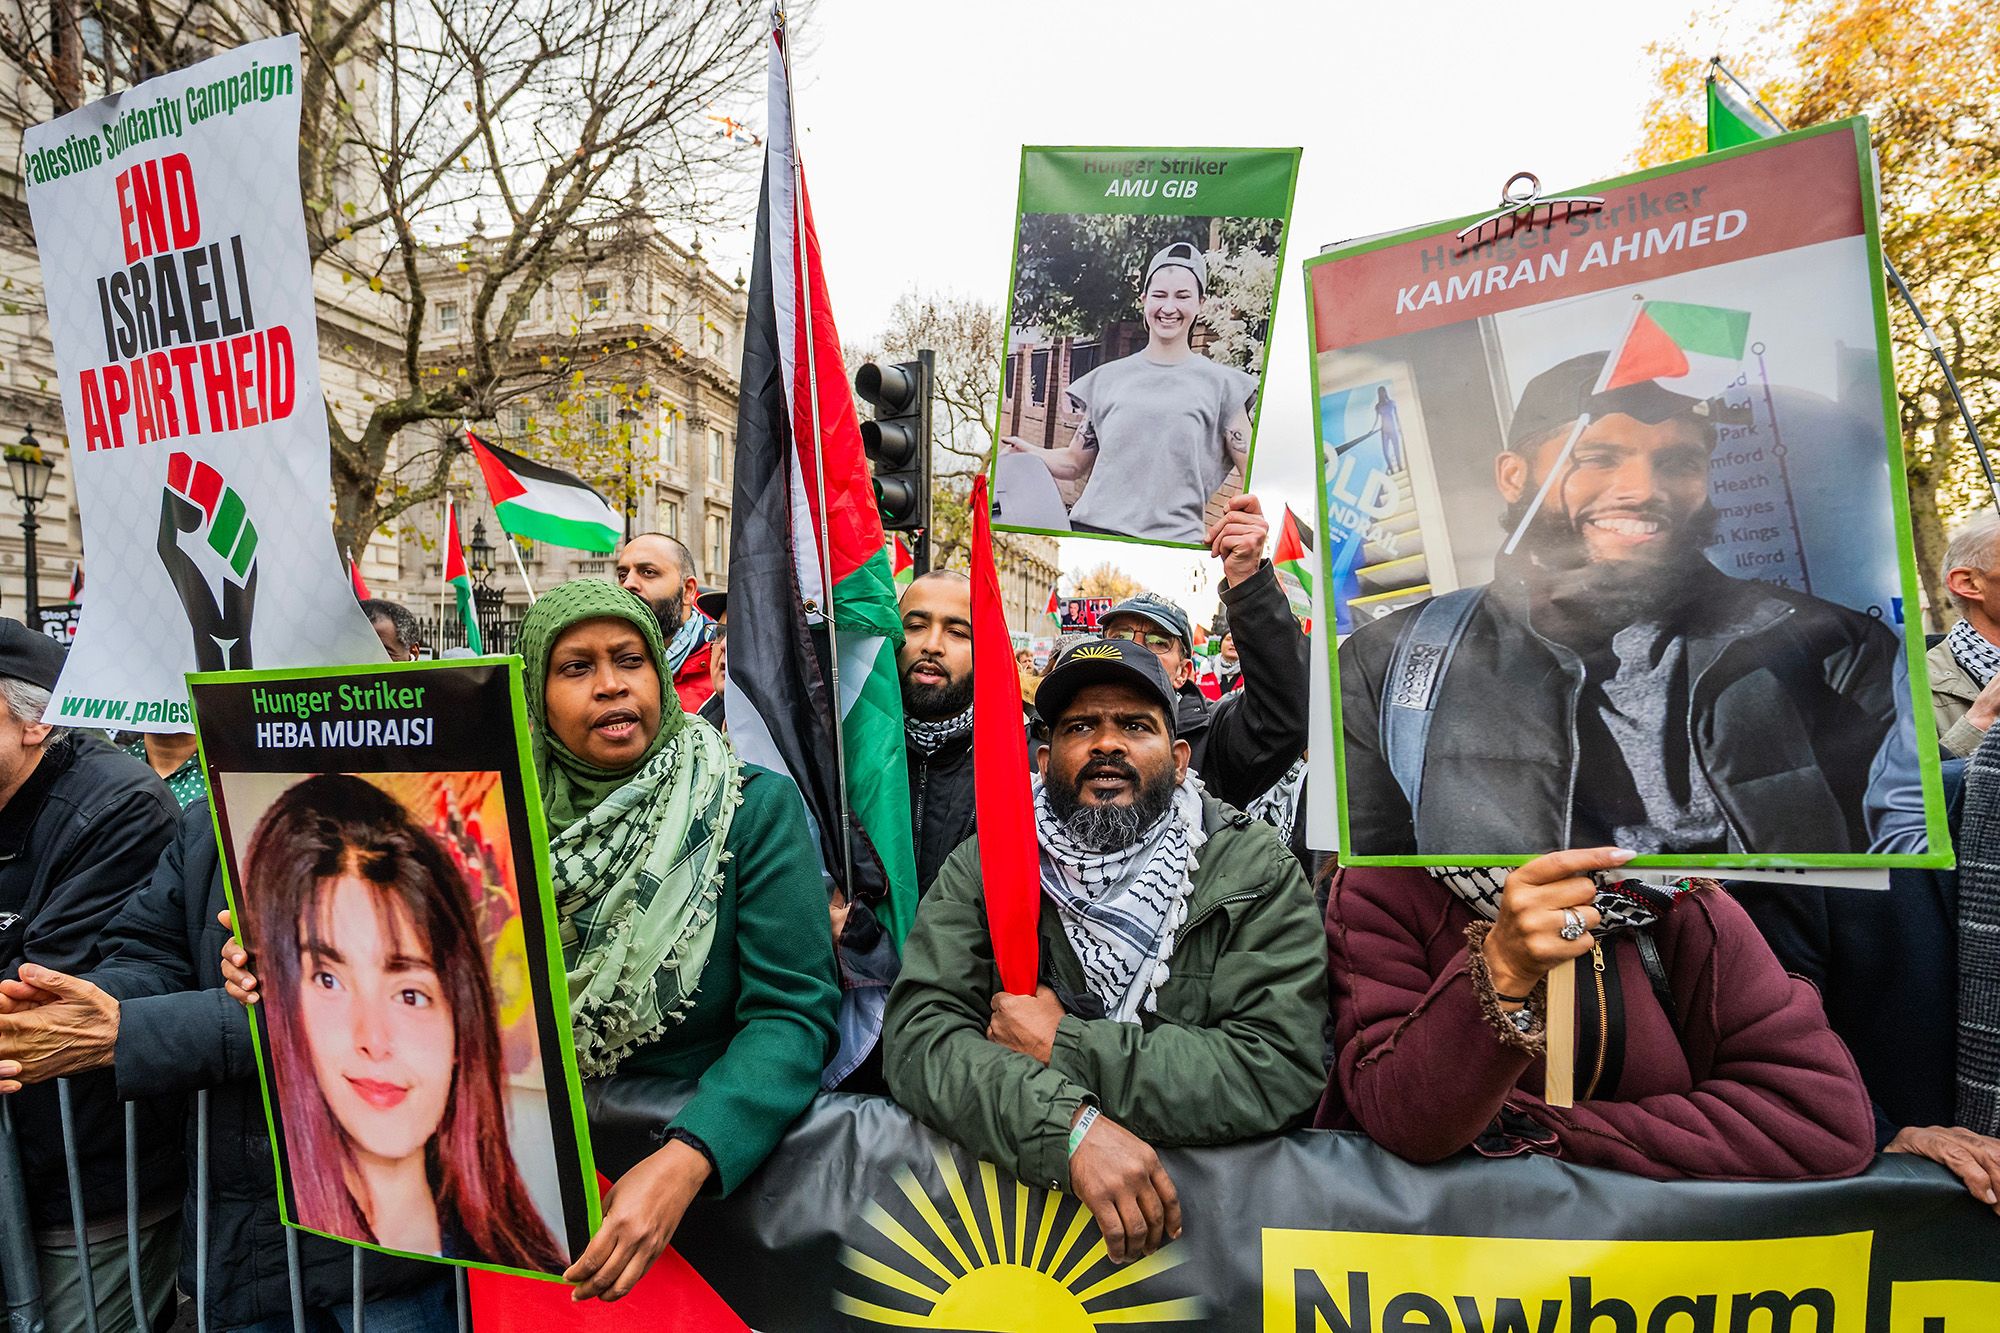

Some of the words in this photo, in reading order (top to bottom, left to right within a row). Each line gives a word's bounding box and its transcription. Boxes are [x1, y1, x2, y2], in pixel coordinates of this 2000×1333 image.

[25, 134, 102, 187] Palestine
[103, 97, 182, 160] Solidarity
[186, 61, 293, 125] Campaign
[1083, 156, 1155, 178] Hunger
[1159, 156, 1228, 176] Striker
[1105, 179, 1158, 198] AMU
[1162, 180, 1199, 199] GIB
[115, 152, 201, 266] END
[1420, 227, 1552, 273] Hunger
[1569, 184, 1708, 238] Striker
[1395, 248, 1569, 315] KAMRAN
[1578, 208, 1748, 273] AHMED
[97, 234, 255, 363] ISRAELI
[79, 324, 297, 453] APARTHEID
[1720, 425, 1759, 441] Park
[1710, 447, 1763, 469] mford
[1323, 440, 1400, 520] OLD
[1714, 474, 1769, 494] Heath
[1718, 502, 1775, 519] mayes
[1328, 501, 1399, 557] NDRAIL
[1731, 526, 1780, 542] Kings
[1736, 550, 1785, 568] Ilford
[251, 688, 332, 719] Hunger
[338, 680, 426, 711] Striker
[257, 721, 315, 748] HEBA
[321, 717, 433, 747] MURAISI
[1080, 1107, 1097, 1130] SAVE
